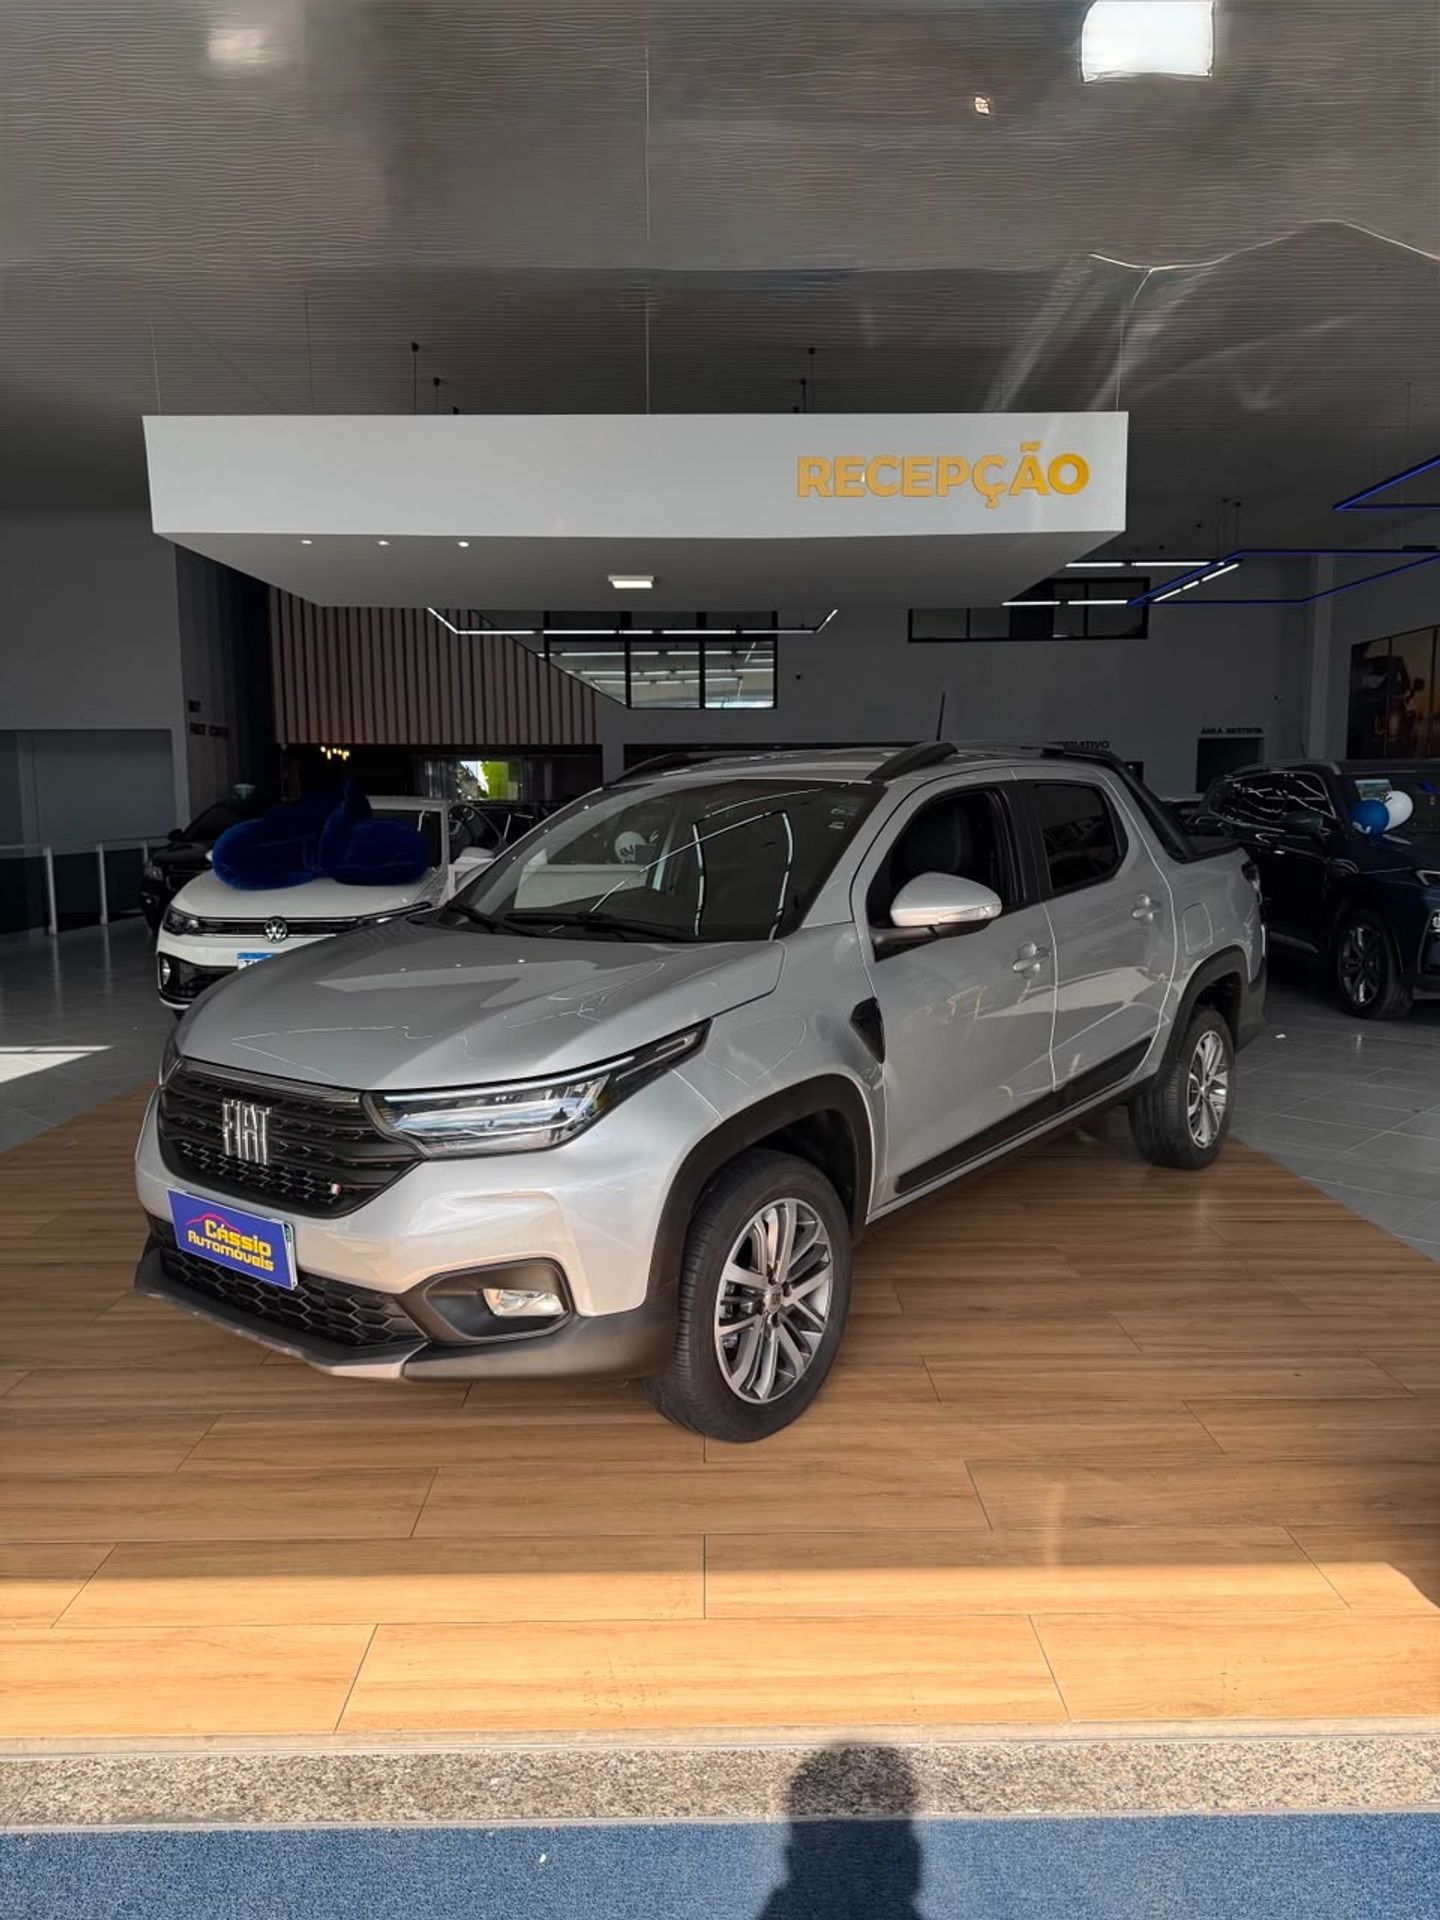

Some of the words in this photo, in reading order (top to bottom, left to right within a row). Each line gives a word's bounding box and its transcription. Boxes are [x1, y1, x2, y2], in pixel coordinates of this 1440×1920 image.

[797, 441, 1090, 509] RECEPÇÃO
[222, 1097, 272, 1165] FIAT
[187, 1229, 275, 1272] Automóveis
[204, 1218, 272, 1258] Cássio
